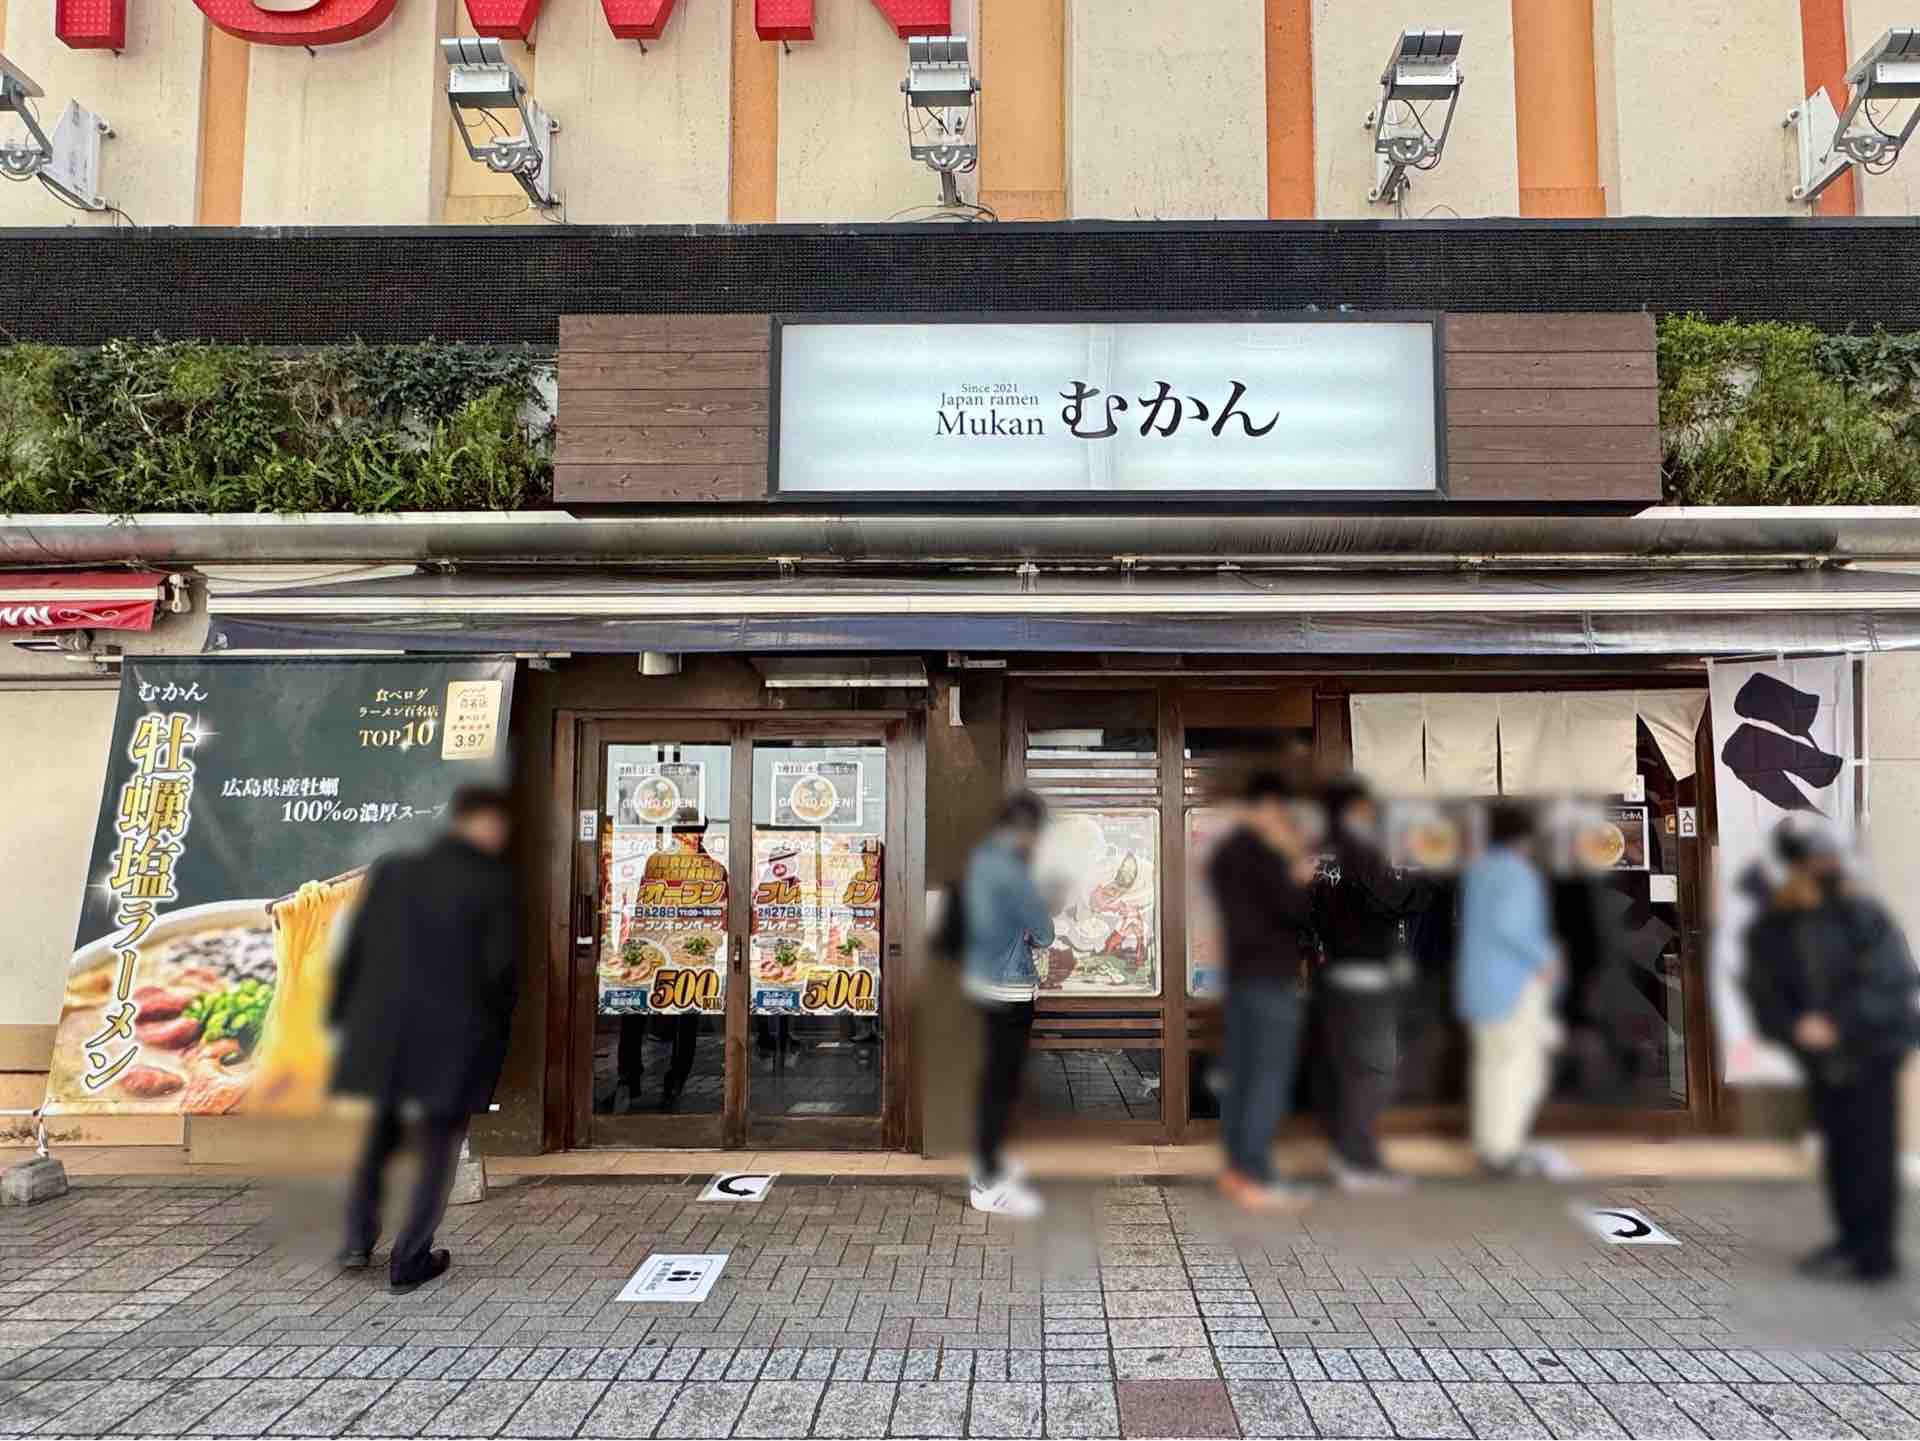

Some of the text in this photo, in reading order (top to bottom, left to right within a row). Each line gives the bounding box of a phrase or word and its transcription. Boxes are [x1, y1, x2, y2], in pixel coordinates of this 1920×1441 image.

[961, 383, 1018, 393] Since 2021
[940, 392, 1039, 409] Japan ramen
[1058, 381, 1280, 440] むかん
[935, 410, 1044, 436] Mukan
[138, 681, 208, 702] むかん
[454, 734, 485, 748] 3.97
[221, 777, 340, 798] 広島県産牡蠣
[1682, 810, 1695, 833] 入口
[84, 713, 195, 1091] 牡蠣塩ラーメン
[650, 968, 720, 1009] 500
[803, 968, 871, 1009] 500
